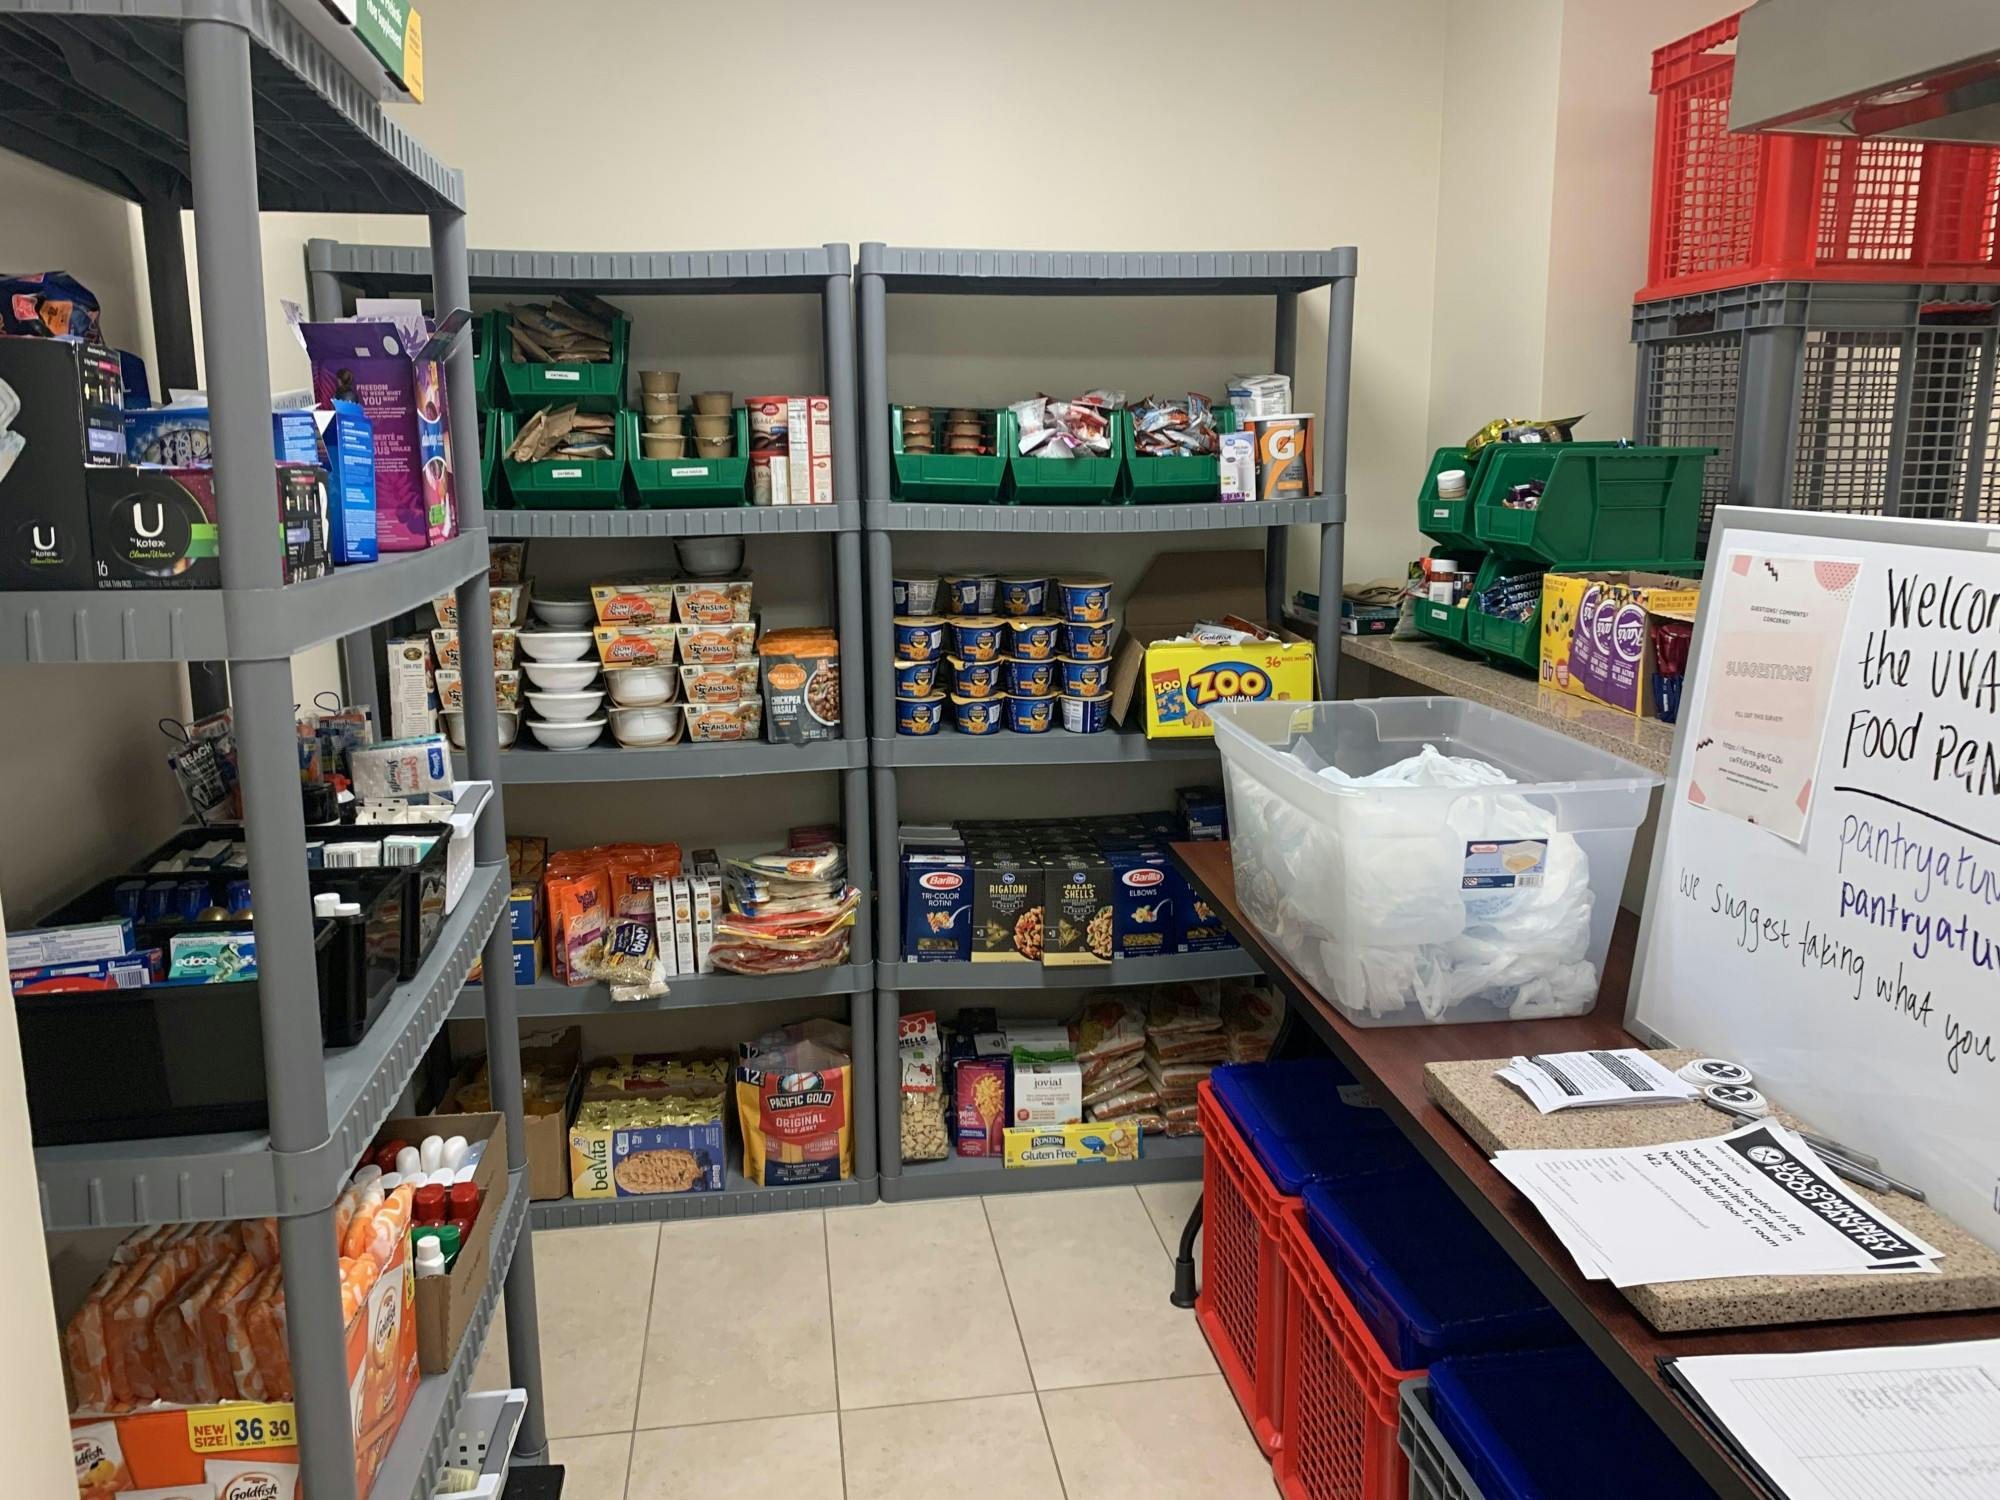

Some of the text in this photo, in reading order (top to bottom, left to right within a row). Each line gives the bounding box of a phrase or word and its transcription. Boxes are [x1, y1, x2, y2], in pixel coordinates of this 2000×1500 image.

[363, 397, 382, 406] YOU
[132, 503, 164, 538] U
[33, 526, 56, 550] U
[136, 537, 166, 548] Kotex
[96, 560, 109, 577] 16
[1265, 656, 1281, 668] 36
[1725, 660, 1814, 682] SUGGESTIONS?
[1858, 629, 2000, 714] the UVA
[1154, 679, 1181, 695] ZOO
[1188, 669, 1266, 706] ZOO
[1222, 695, 1255, 703] ANIMAL
[180, 741, 213, 768] REACH
[929, 876, 959, 886] Barilla
[1133, 873, 1161, 883] Barilla
[921, 892, 960, 900] TRI-COLOR
[989, 884, 1028, 894] RIGATONI
[1064, 889, 1094, 899] SHELLS
[1129, 889, 1157, 897] ELBOWS
[1798, 921, 1865, 1001] taking
[1877, 961, 1935, 1028] what
[1945, 1013, 1997, 1074] you
[899, 1036, 927, 1046] HELLO
[744, 1067, 760, 1085] 12
[1034, 1078, 1062, 1090] jovial
[769, 1093, 832, 1109] PACIFIC GOLD
[776, 1113, 826, 1127] ORIGINAL
[1021, 1149, 1077, 1161] Gluten Free
[582, 1139, 609, 1192] belVita
[1658, 1151, 1703, 1186] Newcomb
[1700, 1184, 1722, 1202] Hall
[1717, 1198, 1745, 1220] Floor
[1749, 1224, 1780, 1249] room
[1675, 1148, 1794, 1242] Student Activities Center in
[1693, 1147, 1806, 1236] we are now located in the
[1765, 1165, 1815, 1202] FOOD
[1813, 1200, 1895, 1254] PANTRY
[1783, 1162, 1909, 1251] UVA COMMUNITY
[194, 1424, 226, 1437] NEW
[234, 1418, 264, 1442] 36
[269, 1420, 291, 1437] 30
[194, 1436, 228, 1448] SIZE!
[75, 1446, 104, 1466] ldfish
[229, 1483, 278, 1500] Goldfish
